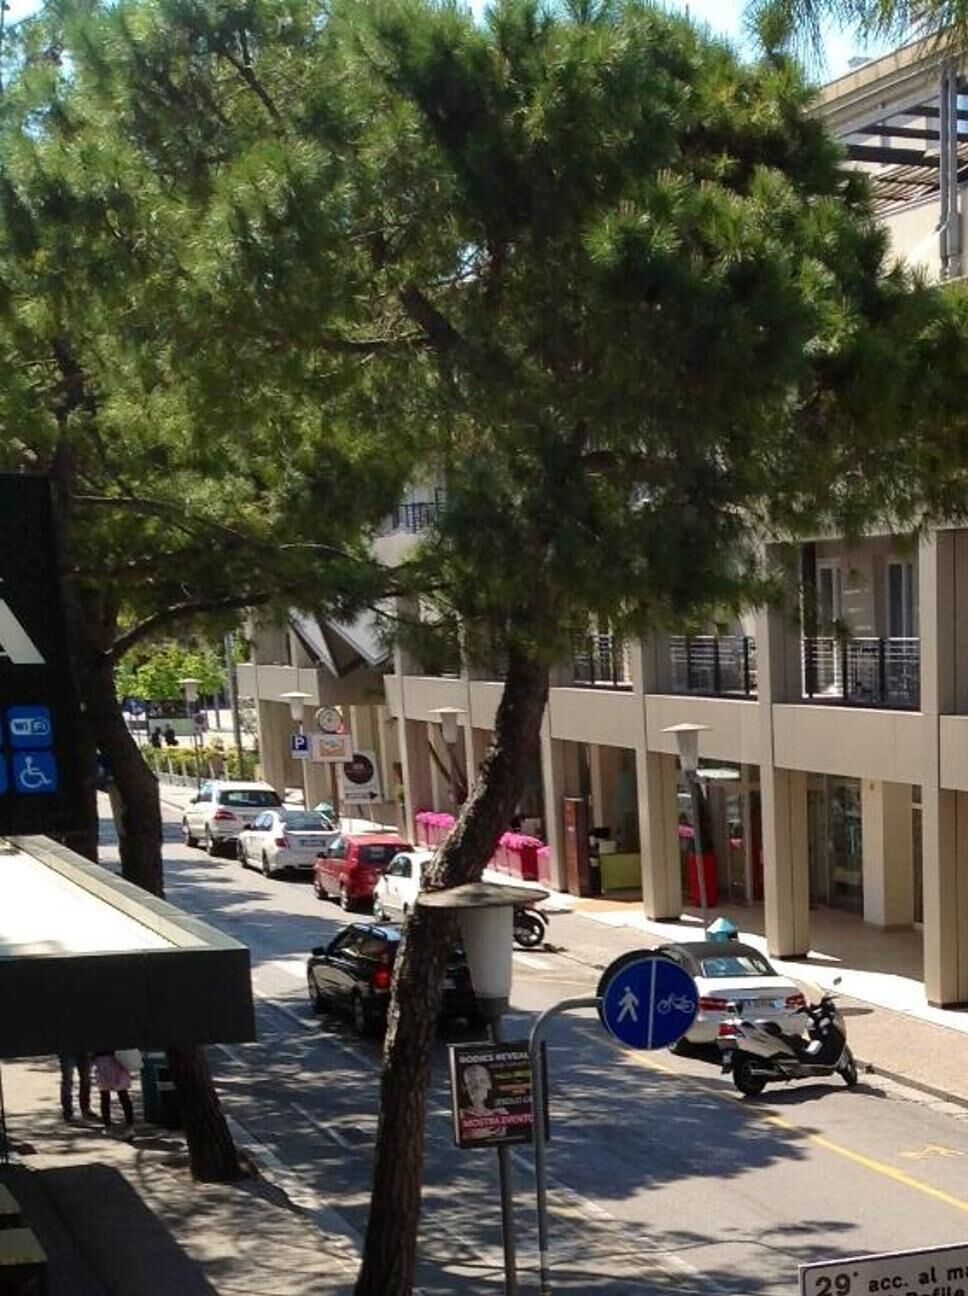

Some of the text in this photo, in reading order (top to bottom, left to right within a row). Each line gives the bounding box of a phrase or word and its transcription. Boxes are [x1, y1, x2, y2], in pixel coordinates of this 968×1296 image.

[295, 737, 305, 749] P
[868, 1276, 909, 1293] acc.
[918, 1267, 937, 1285] al
